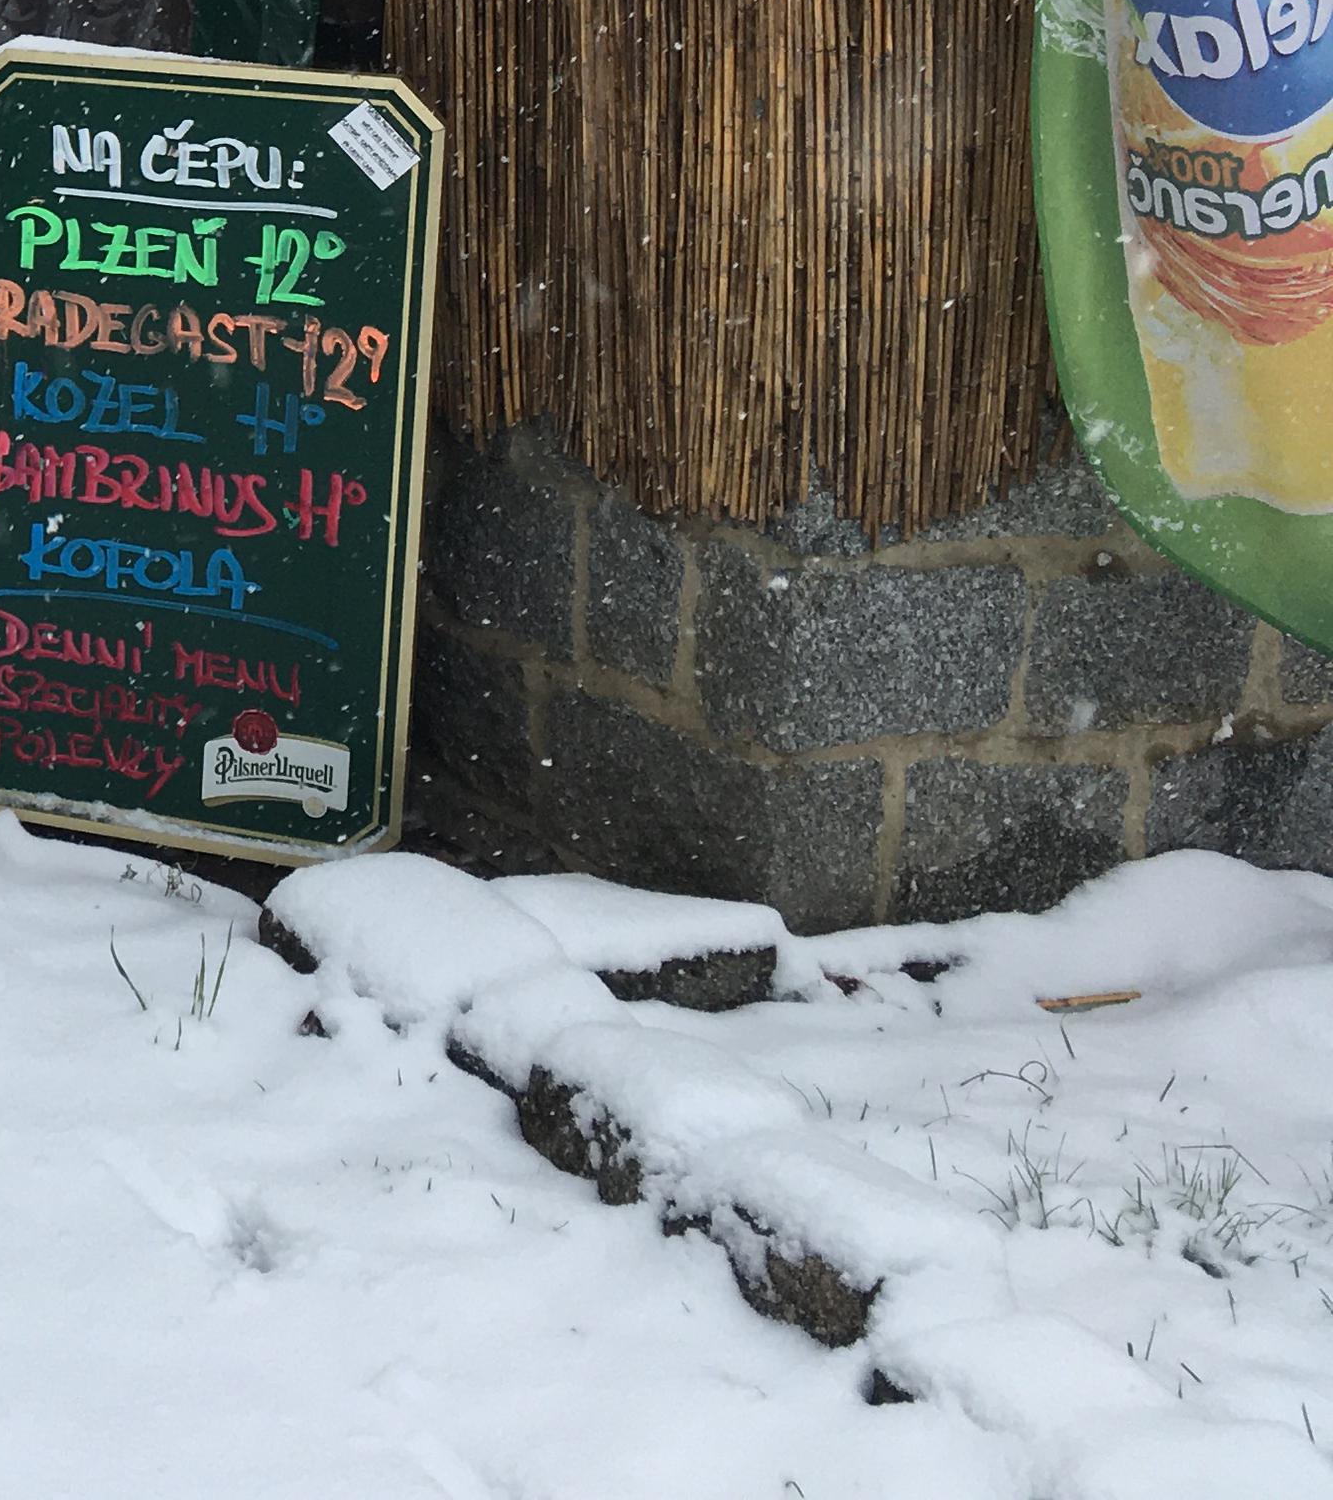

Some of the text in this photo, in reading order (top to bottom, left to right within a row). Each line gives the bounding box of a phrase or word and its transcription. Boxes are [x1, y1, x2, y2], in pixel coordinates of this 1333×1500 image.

[52, 124, 122, 188] NA
[140, 119, 305, 190] ČEPU:
[6, 206, 228, 286] PLZEŇ
[13, 360, 207, 444] KOZEL
[19, 523, 263, 611] KOFOLA
[172, 641, 302, 708] MENU
[213, 746, 334, 790] Pilsner Urquell
